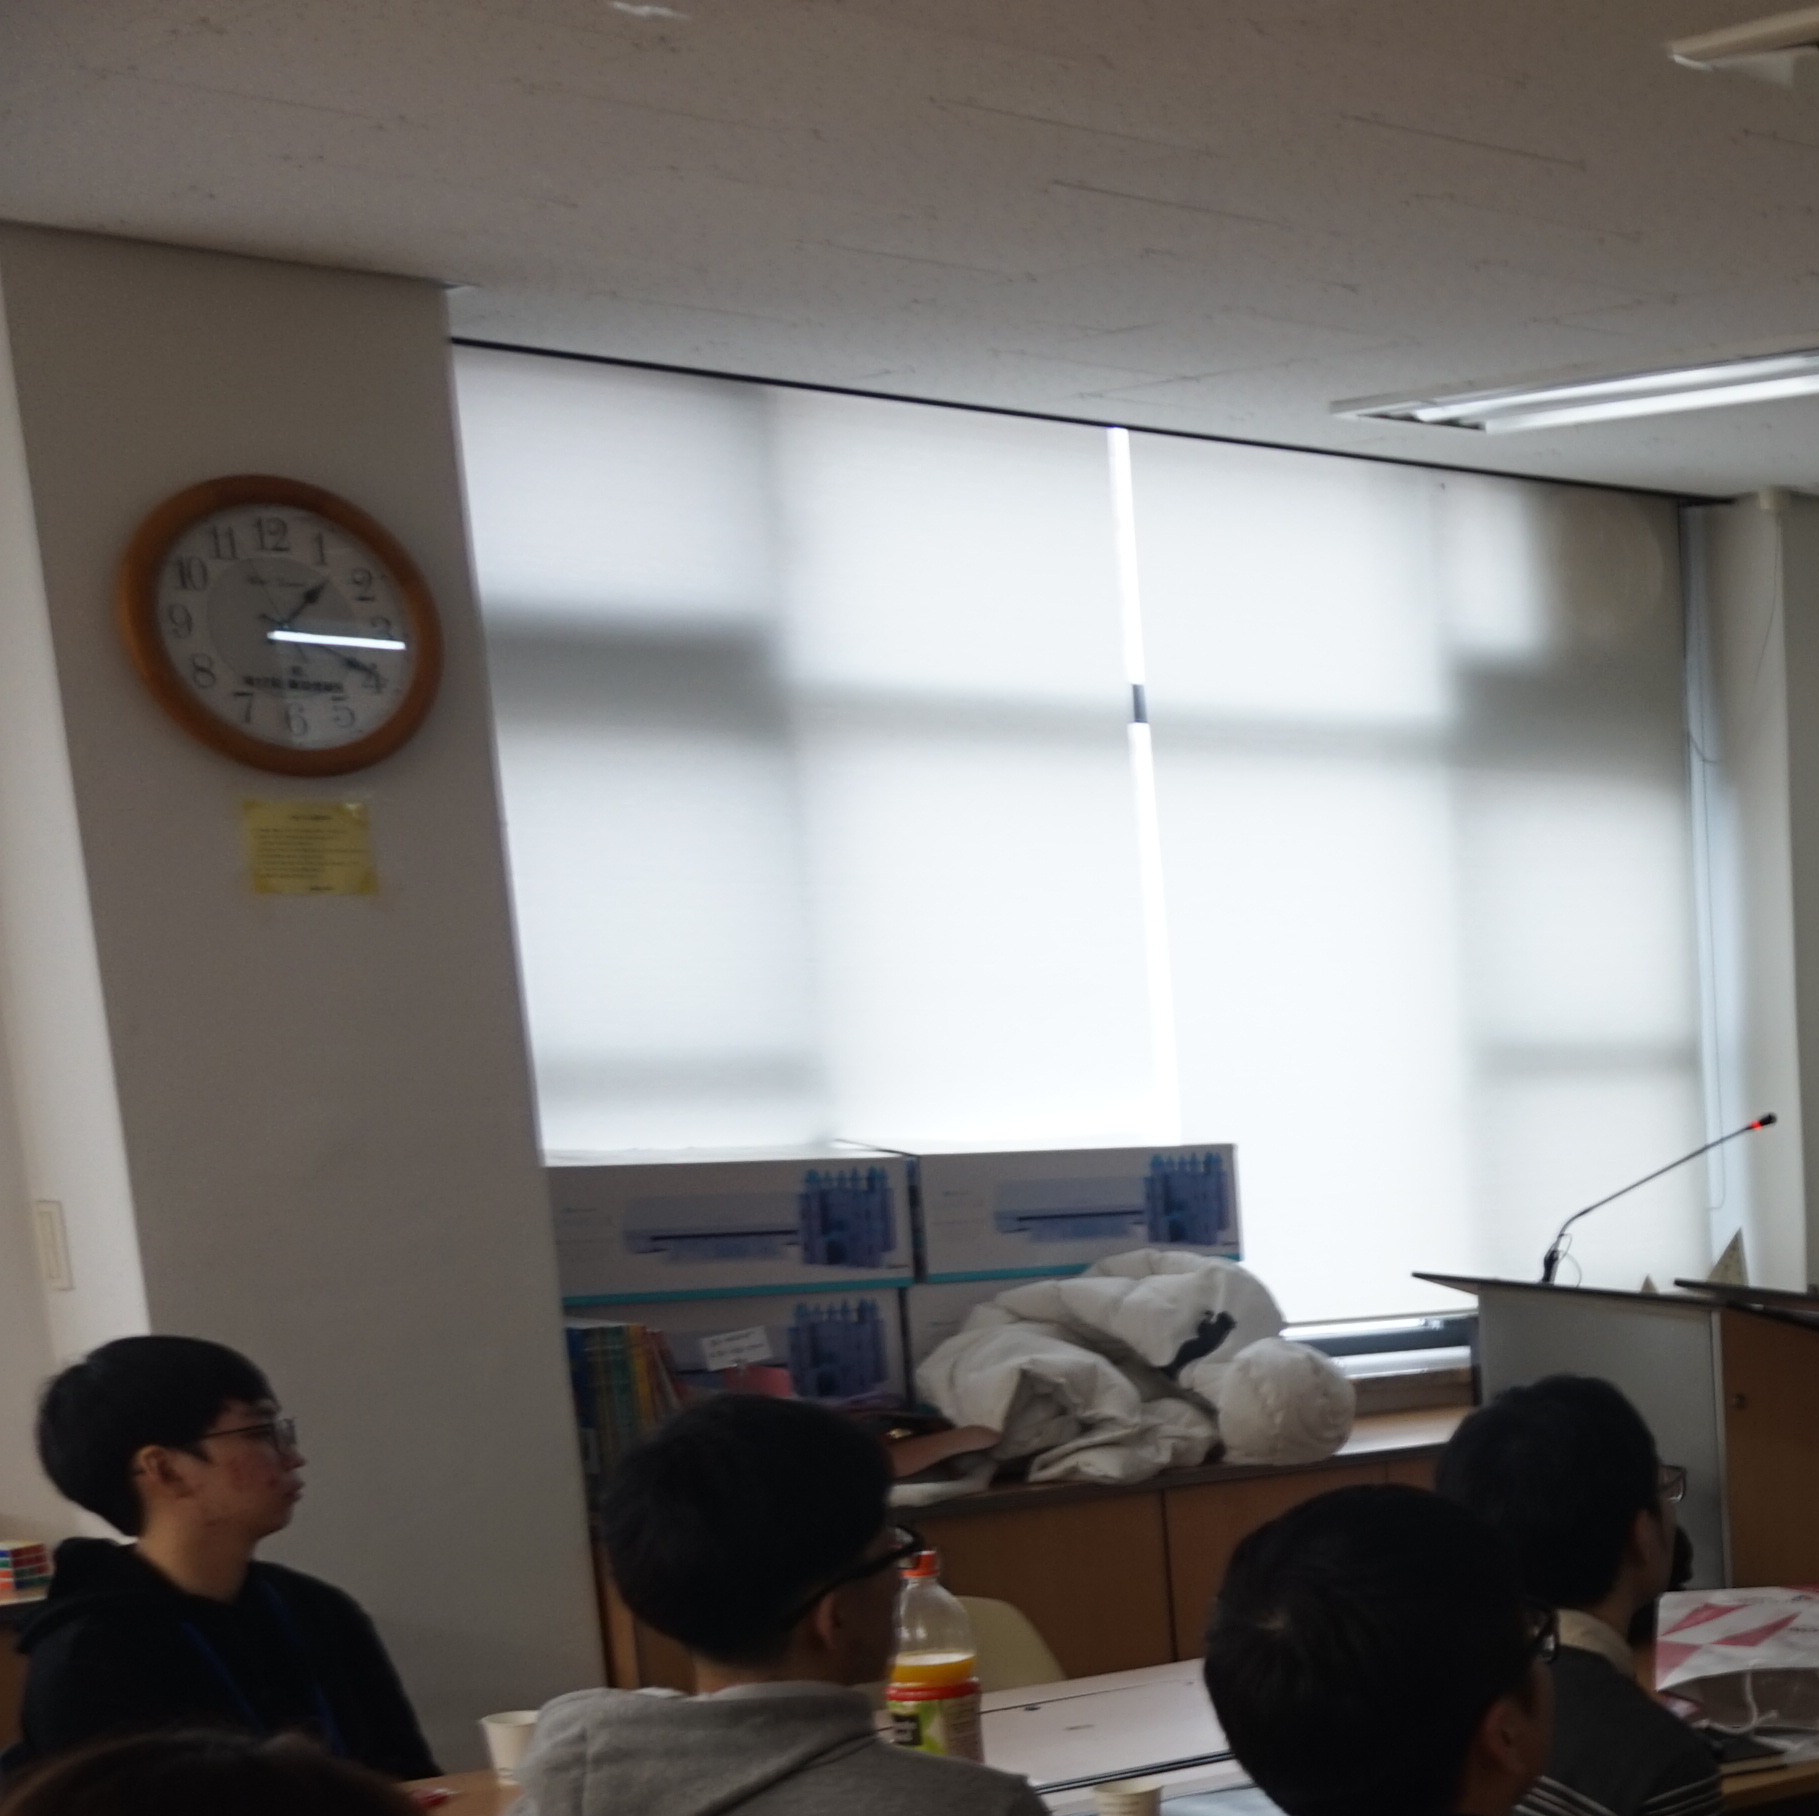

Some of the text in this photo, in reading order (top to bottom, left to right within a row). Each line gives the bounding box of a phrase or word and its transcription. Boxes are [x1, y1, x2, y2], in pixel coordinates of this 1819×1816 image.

[208, 524, 242, 560] 11
[254, 517, 291, 554] 12
[312, 531, 330, 566] 1
[174, 555, 210, 590] 10
[351, 568, 376, 601] 2
[168, 604, 193, 639] 9
[192, 655, 217, 690] 8
[234, 691, 257, 725] 7
[284, 703, 309, 738] 6
[331, 695, 356, 729] 5
